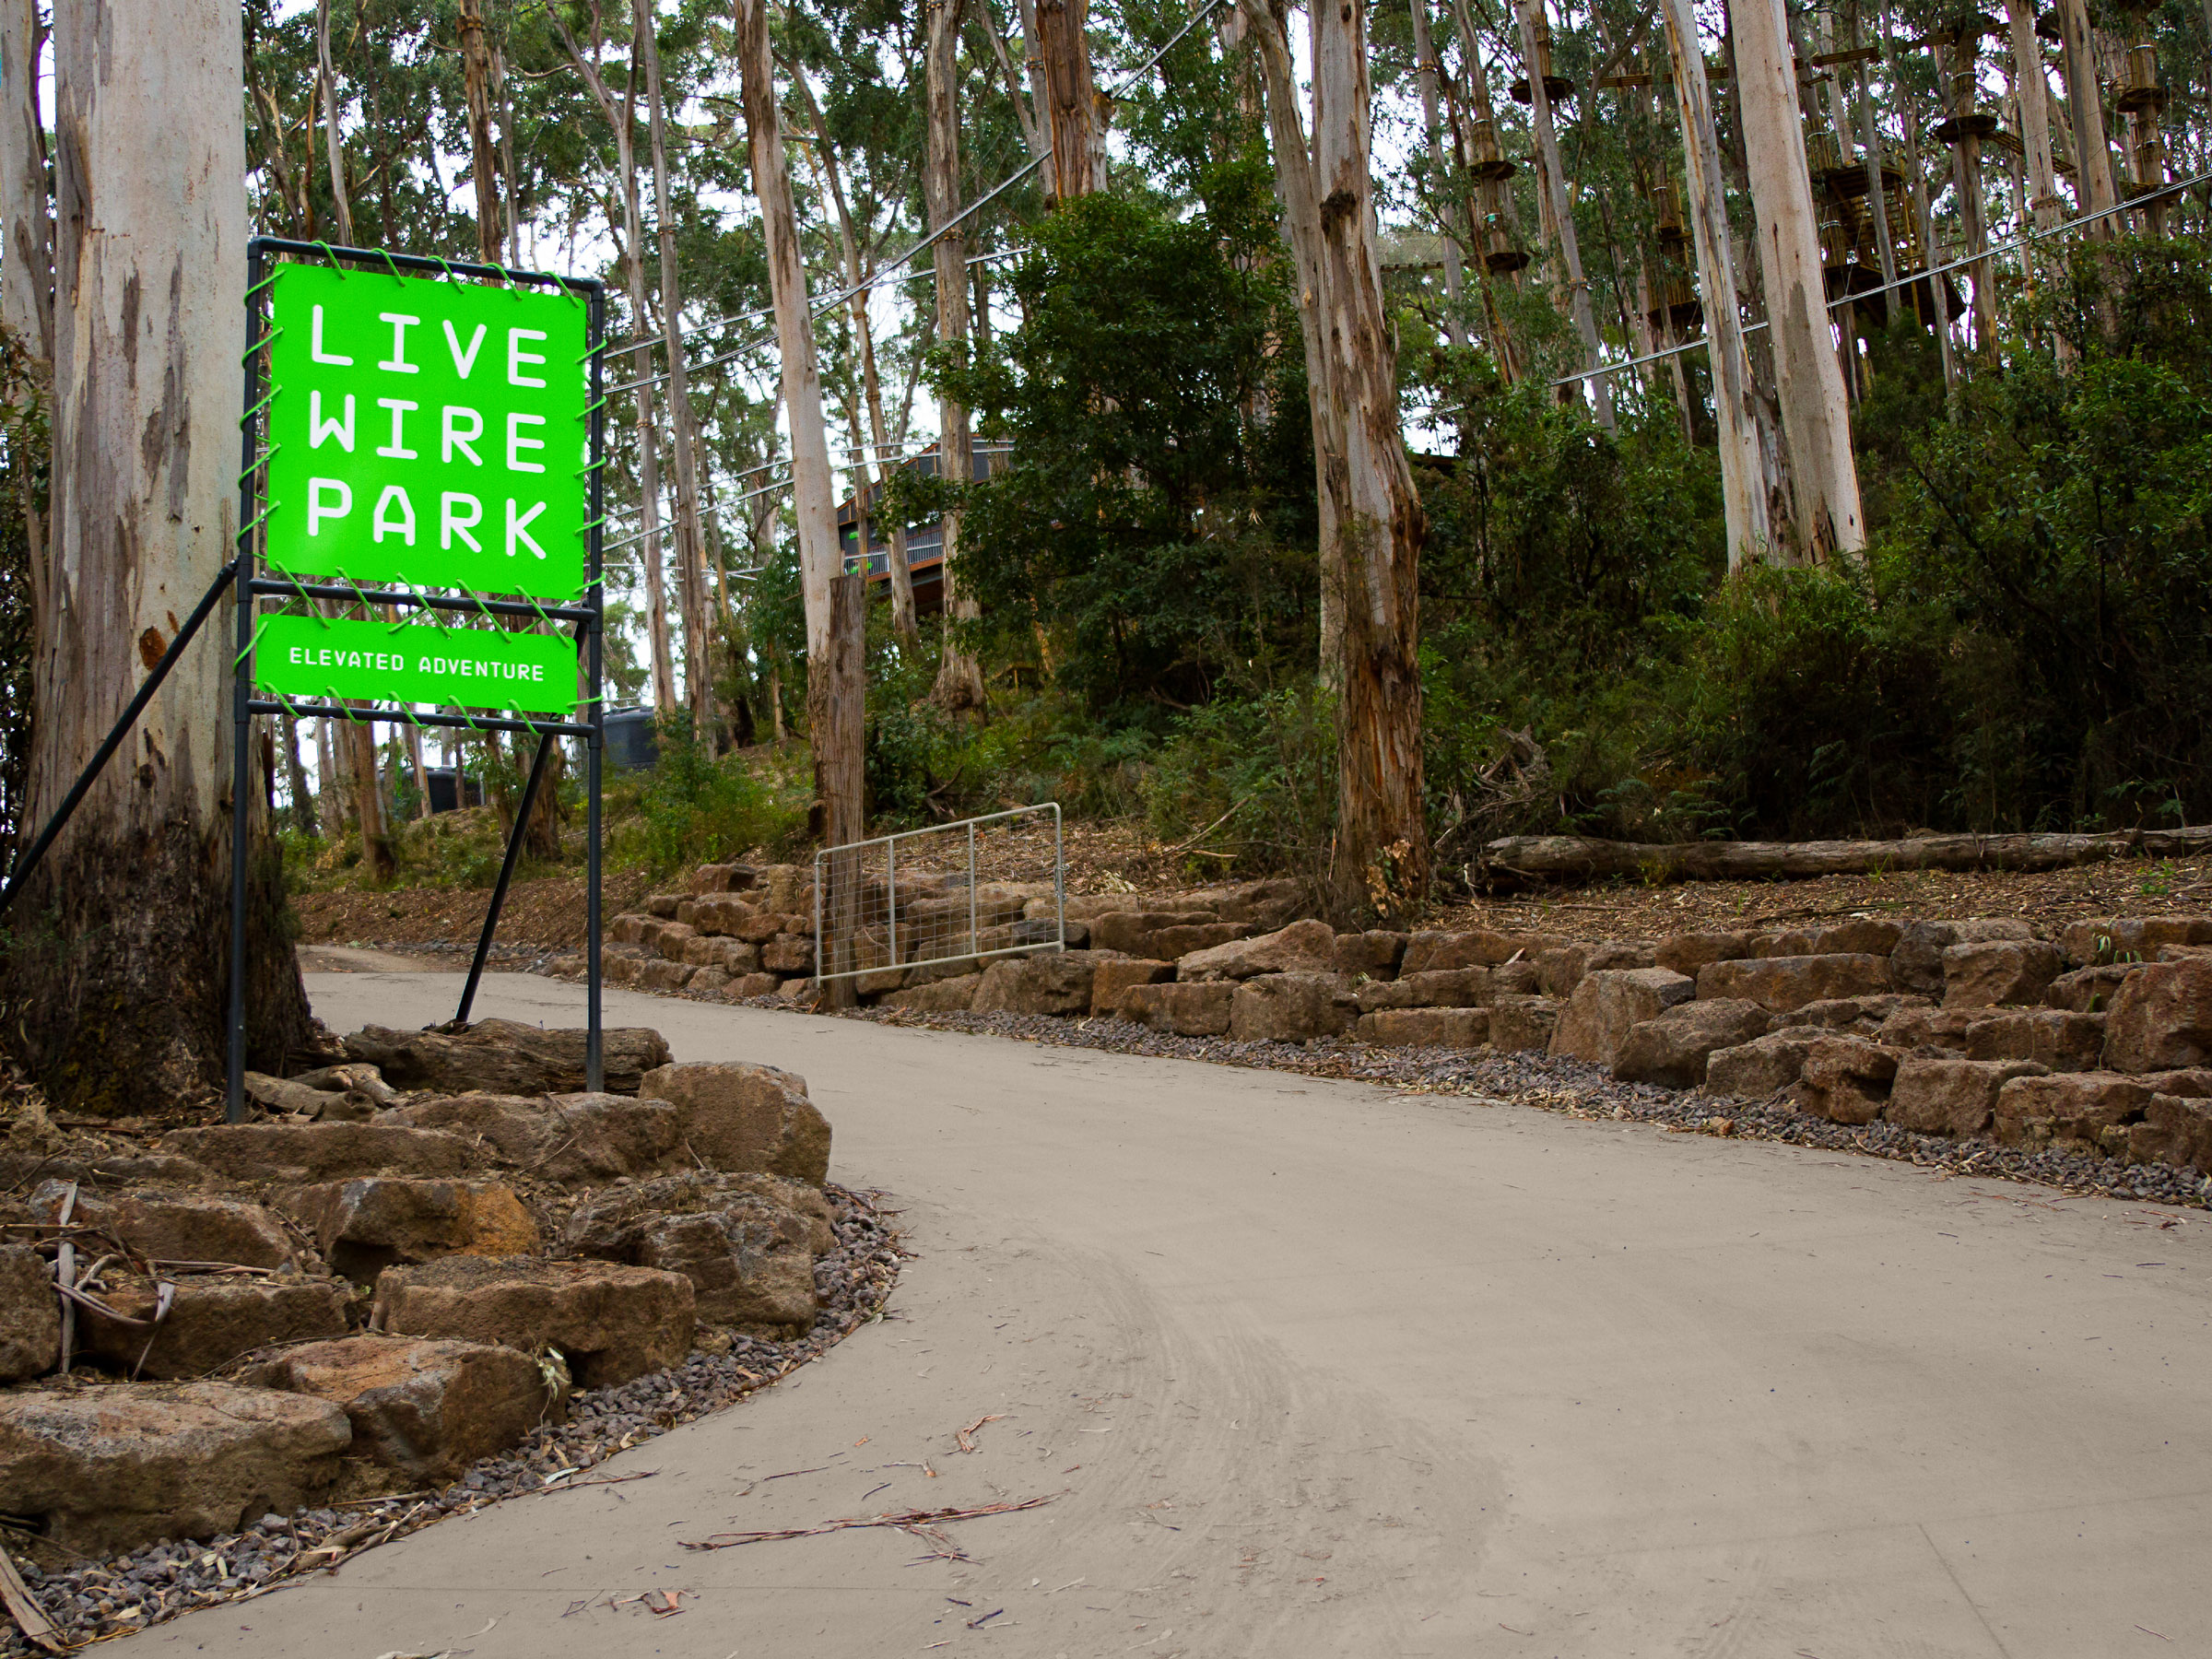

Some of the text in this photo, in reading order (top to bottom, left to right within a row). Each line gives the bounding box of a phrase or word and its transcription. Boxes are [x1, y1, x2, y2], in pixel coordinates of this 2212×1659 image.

[311, 304, 547, 388] LIVE
[309, 390, 546, 473] WIRE
[307, 477, 546, 559] PARK
[289, 647, 545, 682] ELEVATED ADVENTURE
